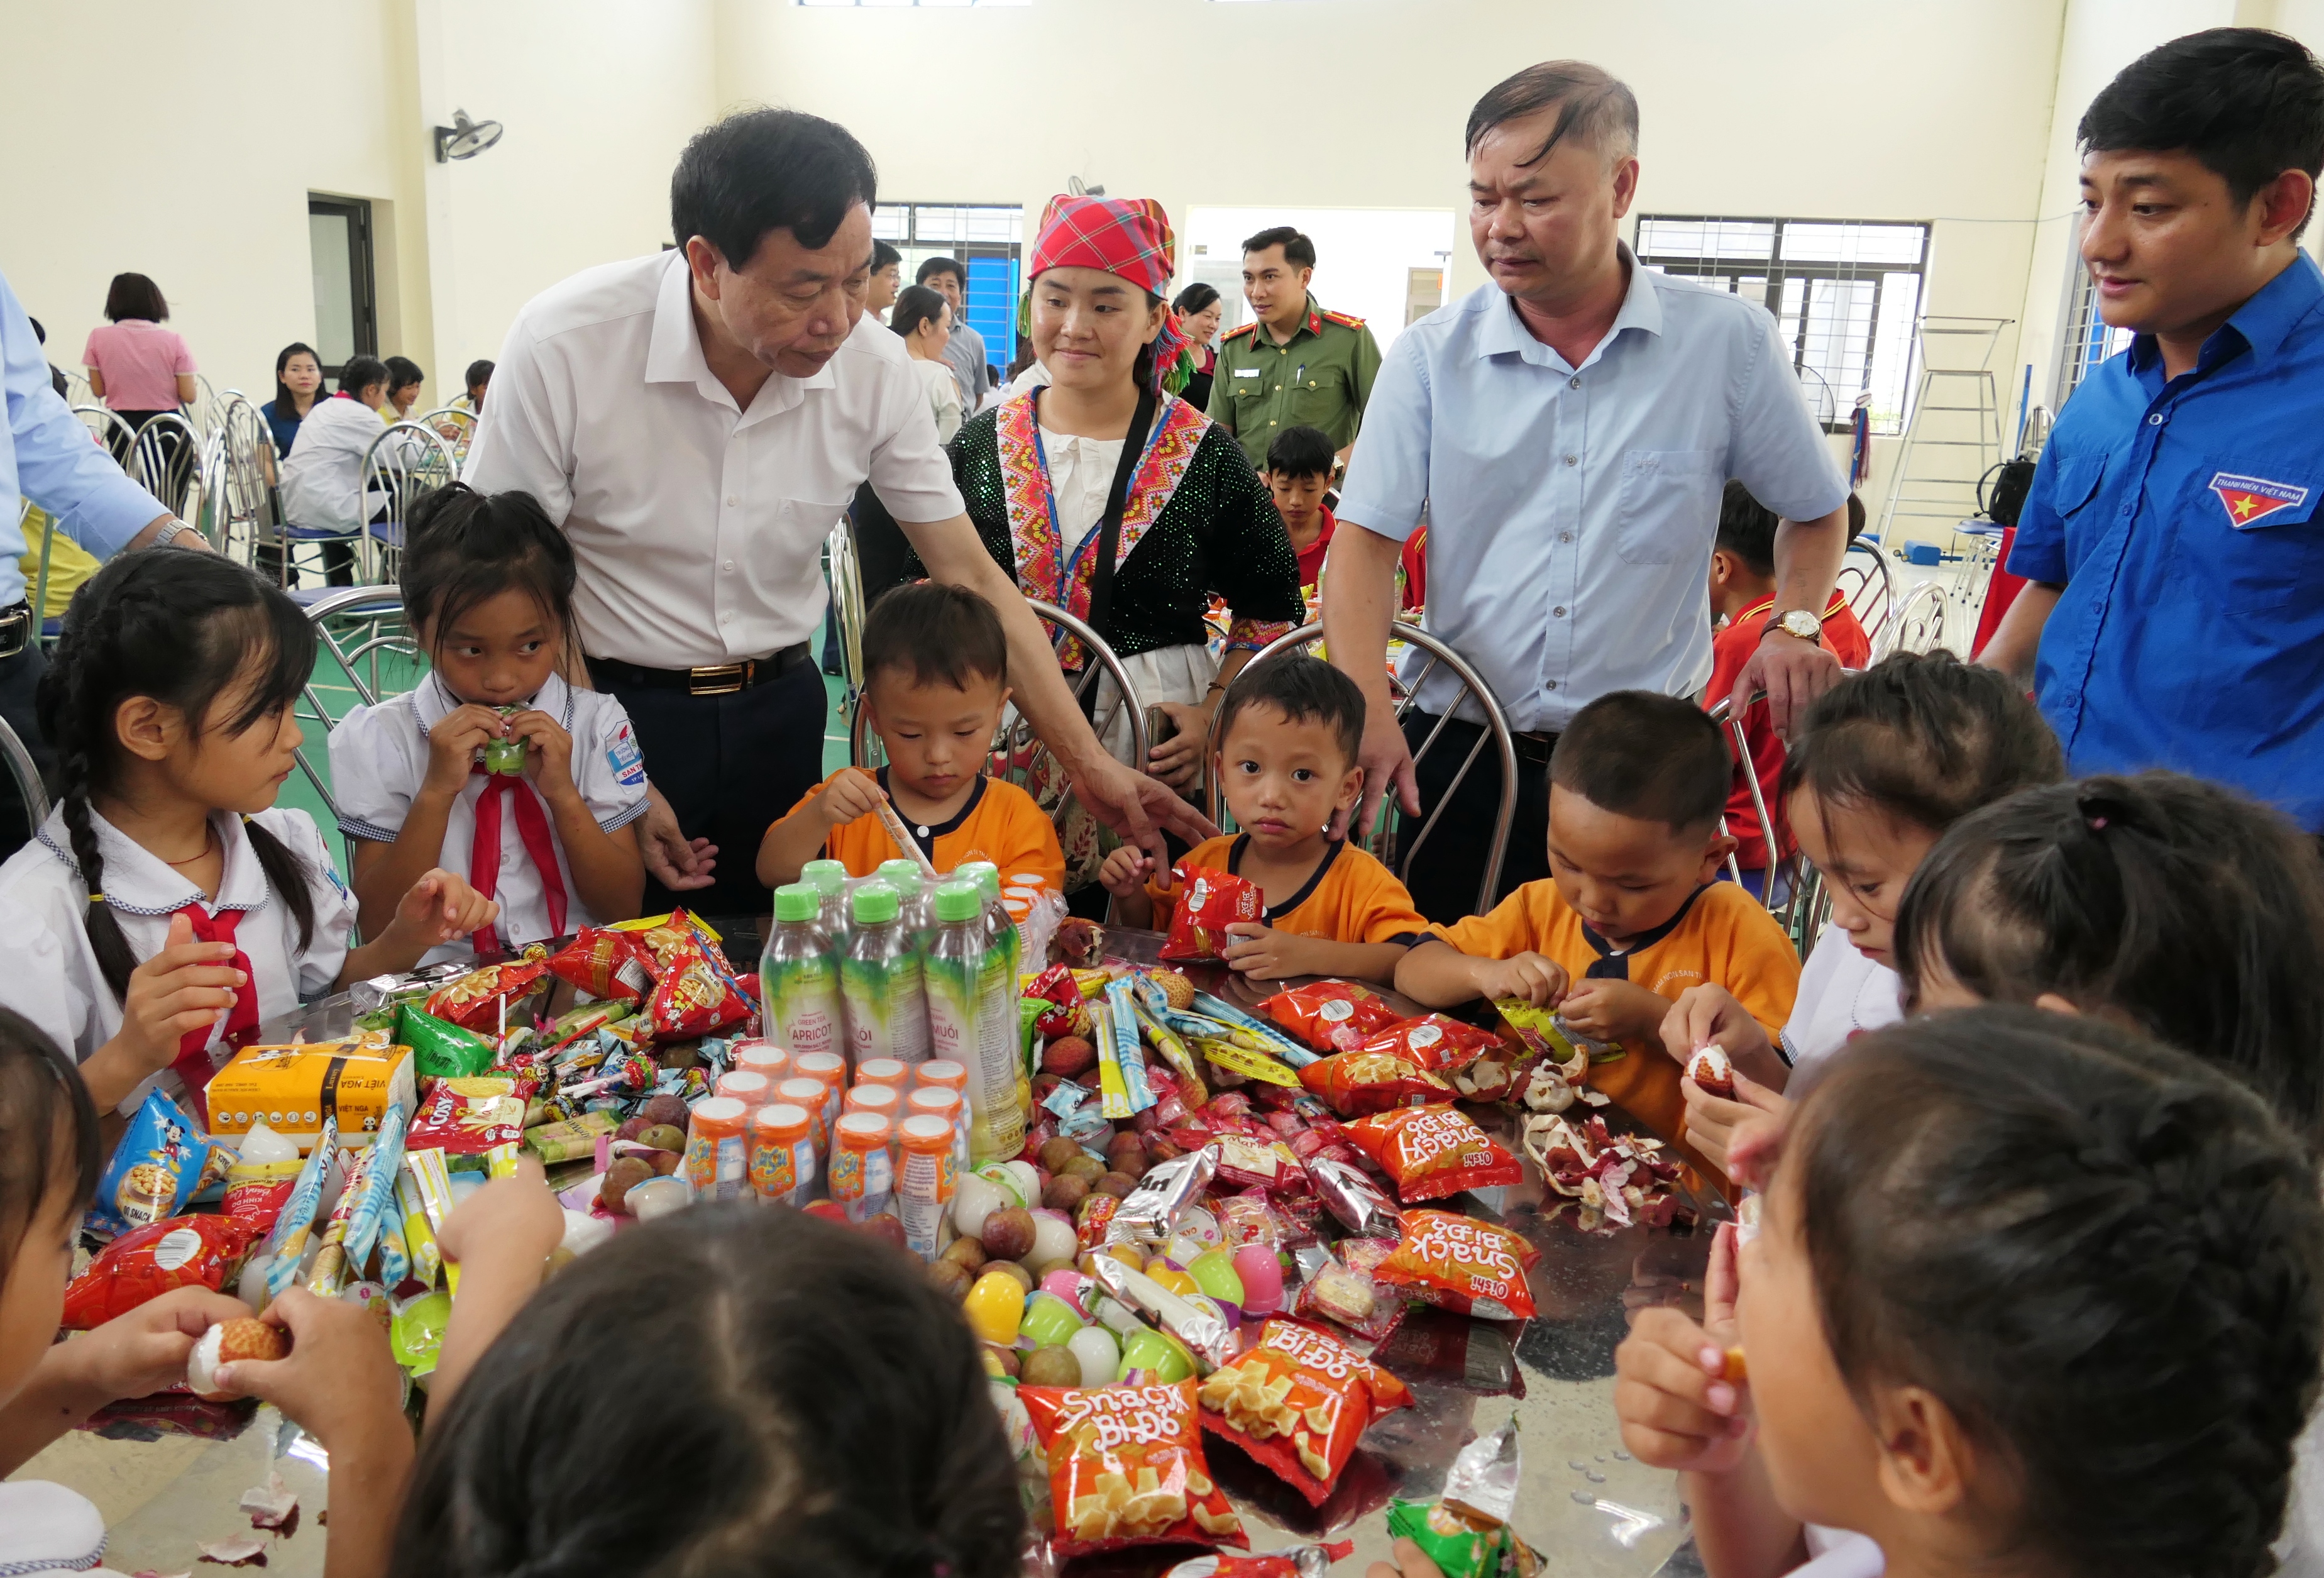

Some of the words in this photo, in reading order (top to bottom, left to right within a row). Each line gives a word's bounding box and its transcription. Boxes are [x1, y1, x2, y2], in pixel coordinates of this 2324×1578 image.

[2217, 478, 2240, 488] THANH
[2240, 482, 2259, 491] NIÊN
[2261, 486, 2279, 496] VIỆT
[2279, 491, 2301, 500] NAM
[622, 768, 636, 778] SAN
[1663, 971, 1678, 983] NON
[1678, 969, 1693, 978] SAN
[798, 1018, 816, 1026] GREEN
[817, 1015, 826, 1024] TEA
[793, 1023, 832, 1040] APRICOT
[933, 1023, 959, 1040] MUỐI
[341, 1079, 362, 1089] NGA
[364, 1078, 386, 1091] VIỆT
[429, 1096, 454, 1126] COSY
[1406, 1115, 1441, 1139] Đỏ
[1228, 1134, 1268, 1150] Marie
[1403, 1125, 1490, 1162] Snack
[1463, 1151, 1493, 1167] Oishi
[230, 1181, 245, 1189] VANI
[130, 1208, 152, 1223] SNACK
[1430, 1217, 1473, 1239] Đỏ
[1409, 1232, 1519, 1279] Snack
[1470, 1274, 1509, 1299] Oishi
[1299, 1347, 1350, 1381] Đỏ
[1062, 1384, 1189, 1420] Snack
[1093, 1413, 1130, 1451] Bí
[1126, 1403, 1181, 1444] Đỏ
